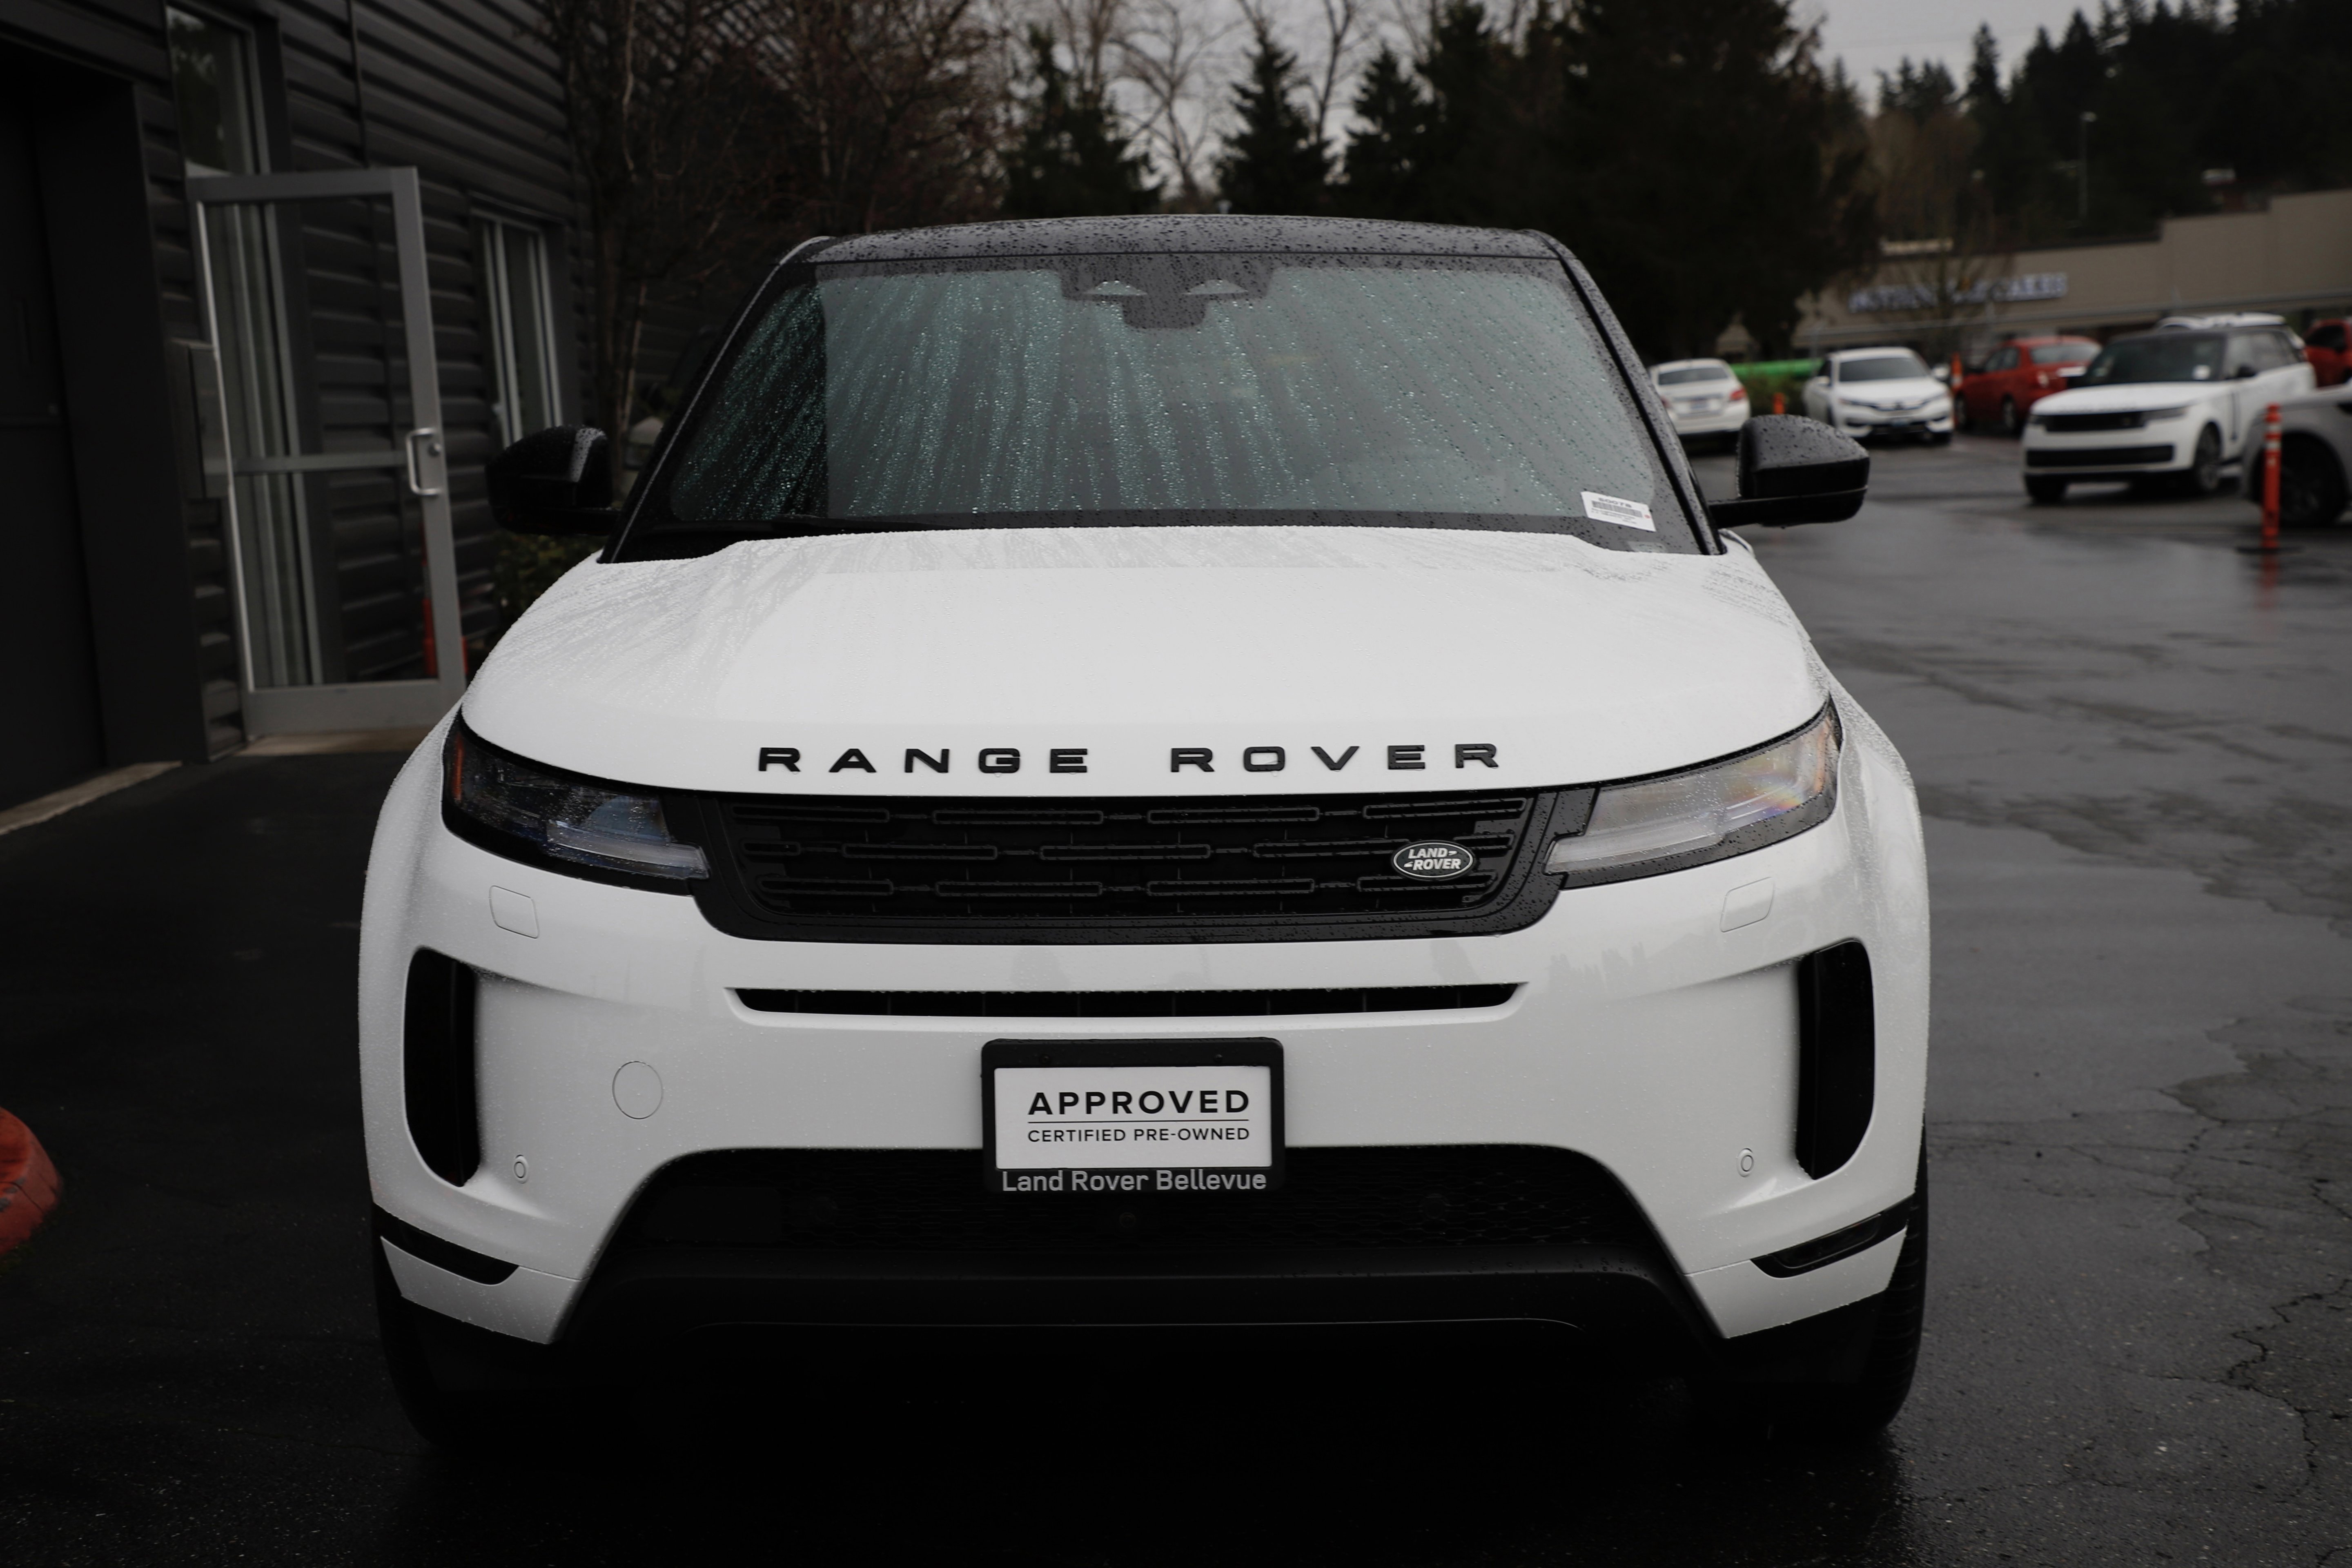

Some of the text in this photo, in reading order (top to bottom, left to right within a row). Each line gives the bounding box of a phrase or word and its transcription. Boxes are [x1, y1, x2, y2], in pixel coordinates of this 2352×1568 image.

[758, 743, 1499, 774] RANGE ROVER
[1408, 848, 1448, 859] LAND
[1412, 858, 1461, 871] ROVER
[1028, 1090, 1250, 1115] APPROVED
[1028, 1127, 1250, 1143] CERTIFIED PRE-OWNED
[1002, 1169, 1267, 1192] Land Rover Bellevue
